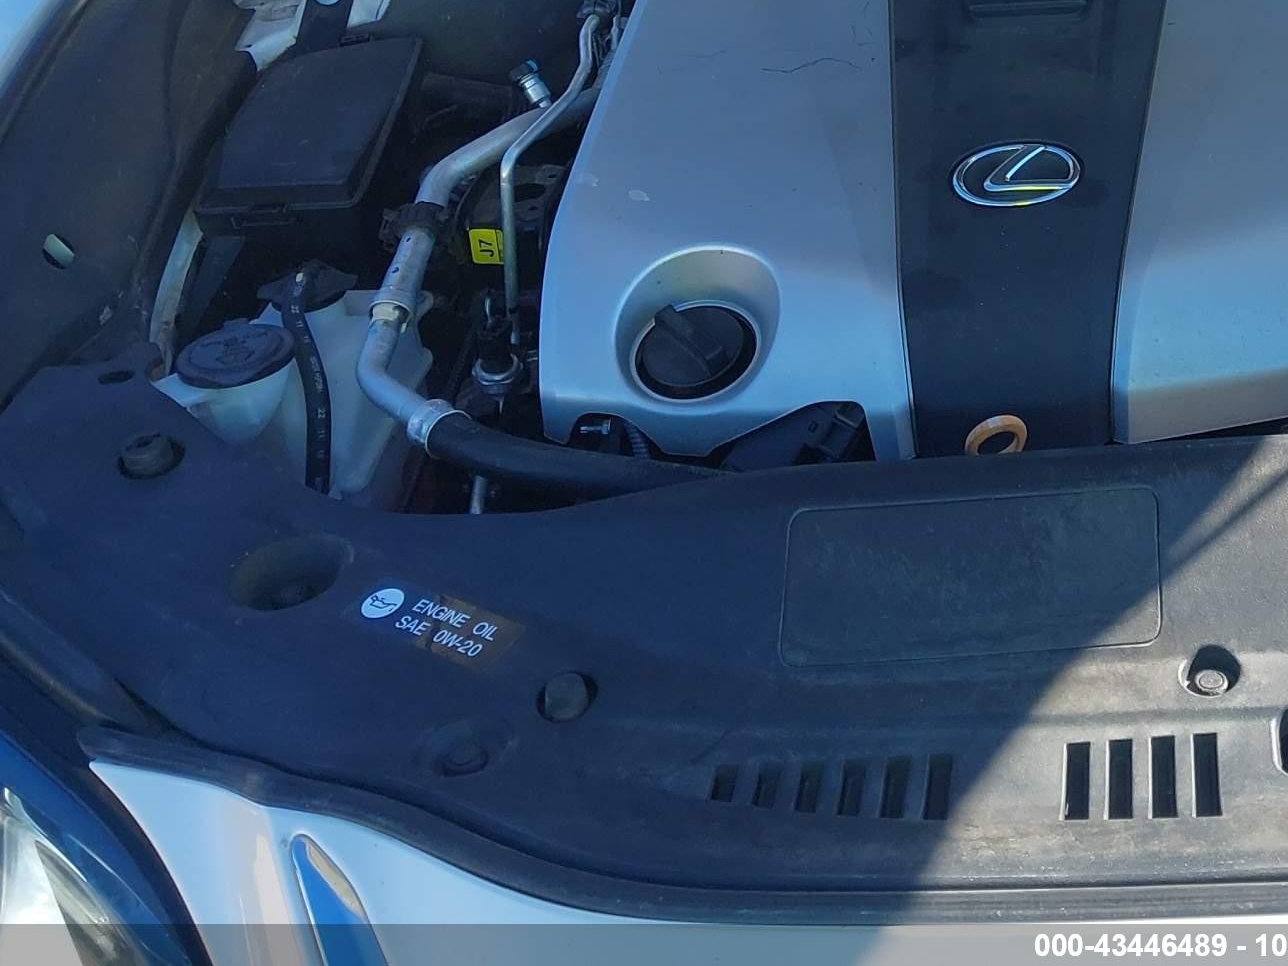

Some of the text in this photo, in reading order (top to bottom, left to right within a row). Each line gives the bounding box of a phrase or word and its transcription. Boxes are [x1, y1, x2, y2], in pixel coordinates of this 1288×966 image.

[478, 238, 495, 258] J7
[317, 407, 326, 419] 22
[412, 599, 499, 641] ENGINE OIL
[395, 616, 483, 657] SAE 0W-20
